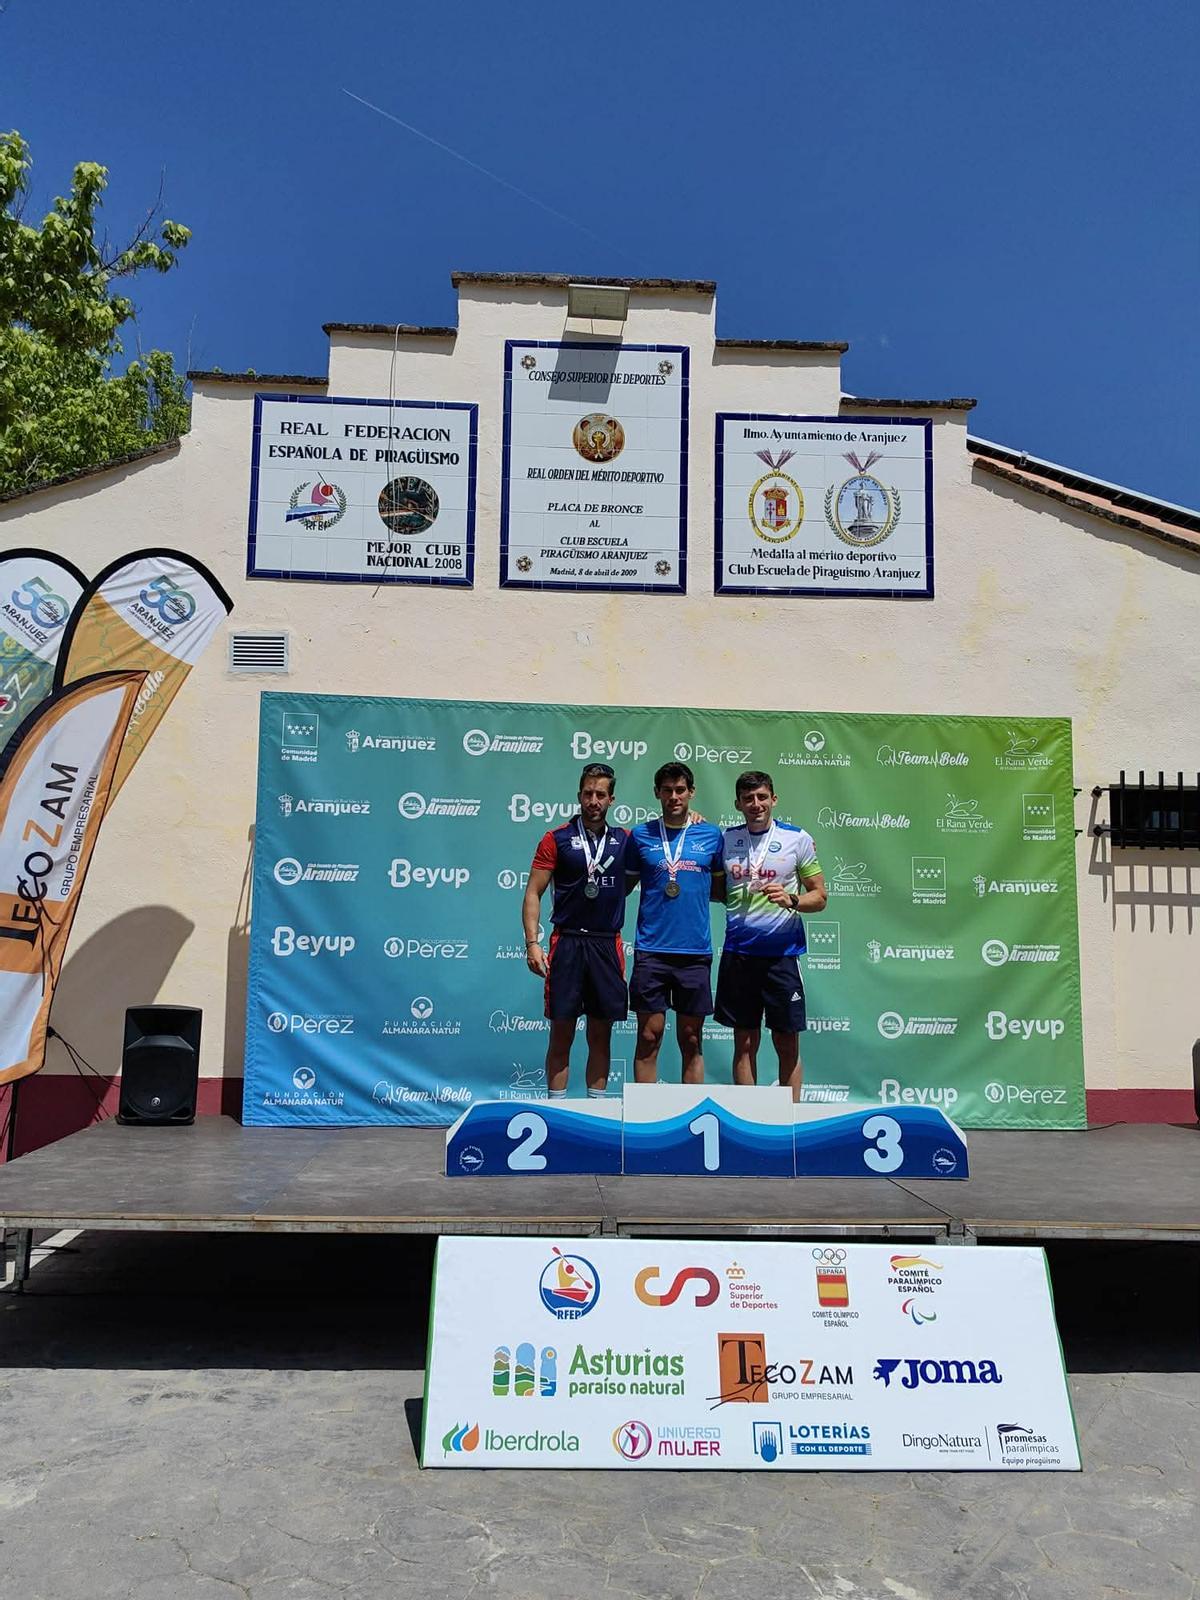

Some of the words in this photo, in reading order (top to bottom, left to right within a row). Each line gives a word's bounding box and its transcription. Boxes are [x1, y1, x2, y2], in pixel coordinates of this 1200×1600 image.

[528, 370, 566, 384] CONSEJO
[566, 371, 609, 384] SUPERIOR
[610, 373, 622, 384] DE
[622, 373, 666, 386] DEPORTES
[280, 421, 329, 436] REAL
[344, 424, 450, 442] FEDERACION
[770, 428, 842, 442] Ayuntamiento
[843, 431, 857, 442] de
[858, 431, 907, 445] Aranjuez
[268, 444, 342, 461] ESPAÑOLA
[350, 448, 368, 462] DE
[375, 448, 460, 465] PIRAGÜISMO
[527, 467, 546, 479] REAL
[548, 469, 574, 480] ORDEN
[575, 470, 591, 481] DEL
[592, 468, 620, 482] MÉRITO
[621, 471, 664, 484] DEPORTIVO
[548, 502, 582, 512] PLACA
[584, 503, 599, 513] DE
[600, 504, 643, 514] BRONCE
[589, 519, 600, 528] AL
[367, 541, 412, 554] MEJOR
[425, 544, 461, 556] CLUB
[560, 536, 586, 546] CLUB
[587, 537, 628, 547] ESCUELA
[367, 555, 434, 569] NACIONAL
[600, 550, 648, 560] ARANJUEZ
[751, 548, 794, 560] Medalla
[797, 550, 807, 560] al
[809, 549, 843, 561] mérito
[846, 551, 897, 564] deportivo
[584, 568, 593, 576] de
[594, 568, 610, 576] abril
[621, 569, 637, 577] 2009
[728, 564, 755, 576] Club
[757, 565, 795, 576] Escuela
[797, 566, 810, 576] de
[872, 567, 921, 582] Aranjuez
[2, 604, 48, 643] ARANJUEZ
[130, 602, 175, 640] ARANJUEZ
[362, 735, 436, 752] Aranjuez
[489, 740, 544, 753] Aranjuez
[570, 731, 648, 760] Beyup
[281, 748, 317, 756] Comunidad
[898, 751, 930, 765] Team
[995, 757, 1002, 766] El
[1006, 757, 1025, 766] Rana
[1028, 757, 1053, 766] Verde
[295, 800, 370, 816] Aranjuez
[425, 802, 480, 816] Aranjuez
[839, 814, 870, 826] Team
[936, 819, 944, 828] El
[946, 819, 966, 828] Rana
[968, 820, 993, 829] Verde
[60, 854, 79, 896] GRUPO
[71, 774, 98, 852] EMPRESARIAL
[301, 868, 360, 882] Aranjuez
[388, 858, 470, 889] Beyup
[856, 883, 882, 893] Verde
[988, 881, 1058, 895] Aranjuez
[271, 926, 355, 957] Beyup
[884, 946, 954, 961] Aranjuez
[1008, 949, 1061, 962] Aranjuez
[382, 1027, 430, 1035] ALMANARA
[807, 1020, 850, 1034] njuez
[904, 1022, 958, 1035] Aranjuez
[985, 1010, 1065, 1040] Beyup
[396, 1088, 429, 1102] Team
[878, 1078, 958, 1108] Beyup
[263, 1098, 313, 1106] ALMANARA
[314, 1098, 343, 1106] NATUR
[506, 1111, 548, 1170] 2
[689, 1113, 720, 1172] 1
[862, 1114, 904, 1174] 3
[899, 1268, 929, 1277] COMITÉ
[729, 1283, 761, 1292] Consejo
[888, 1276, 942, 1285] PARALÍMPICO
[898, 1284, 934, 1293] ESPAÑOL
[729, 1292, 763, 1301] Superior
[742, 1301, 778, 1310] Deportes
[557, 1309, 582, 1320] RFEP
[812, 1310, 832, 1318] COMITÉ
[833, 1310, 859, 1319] OLÍMPICO
[824, 1319, 849, 1328] ESPAÑOL
[569, 1344, 684, 1376] Asturias
[569, 1377, 627, 1398] paraíso
[630, 1380, 684, 1395] natural
[771, 1392, 799, 1400] GRUPO
[801, 1392, 853, 1400] EMPRESARIAL
[657, 1427, 721, 1439] UNIVERSO
[789, 1423, 870, 1439] LOTERÍAS
[485, 1429, 579, 1451] Iberdrola
[903, 1434, 981, 1449] DingoNatura
[1004, 1434, 1047, 1444] promesas
[657, 1440, 721, 1456] MUJER
[800, 1445, 814, 1453] CON
[816, 1445, 826, 1453] EL
[828, 1445, 863, 1453] DEPORTE
[1002, 1456, 1024, 1465] Equipo
